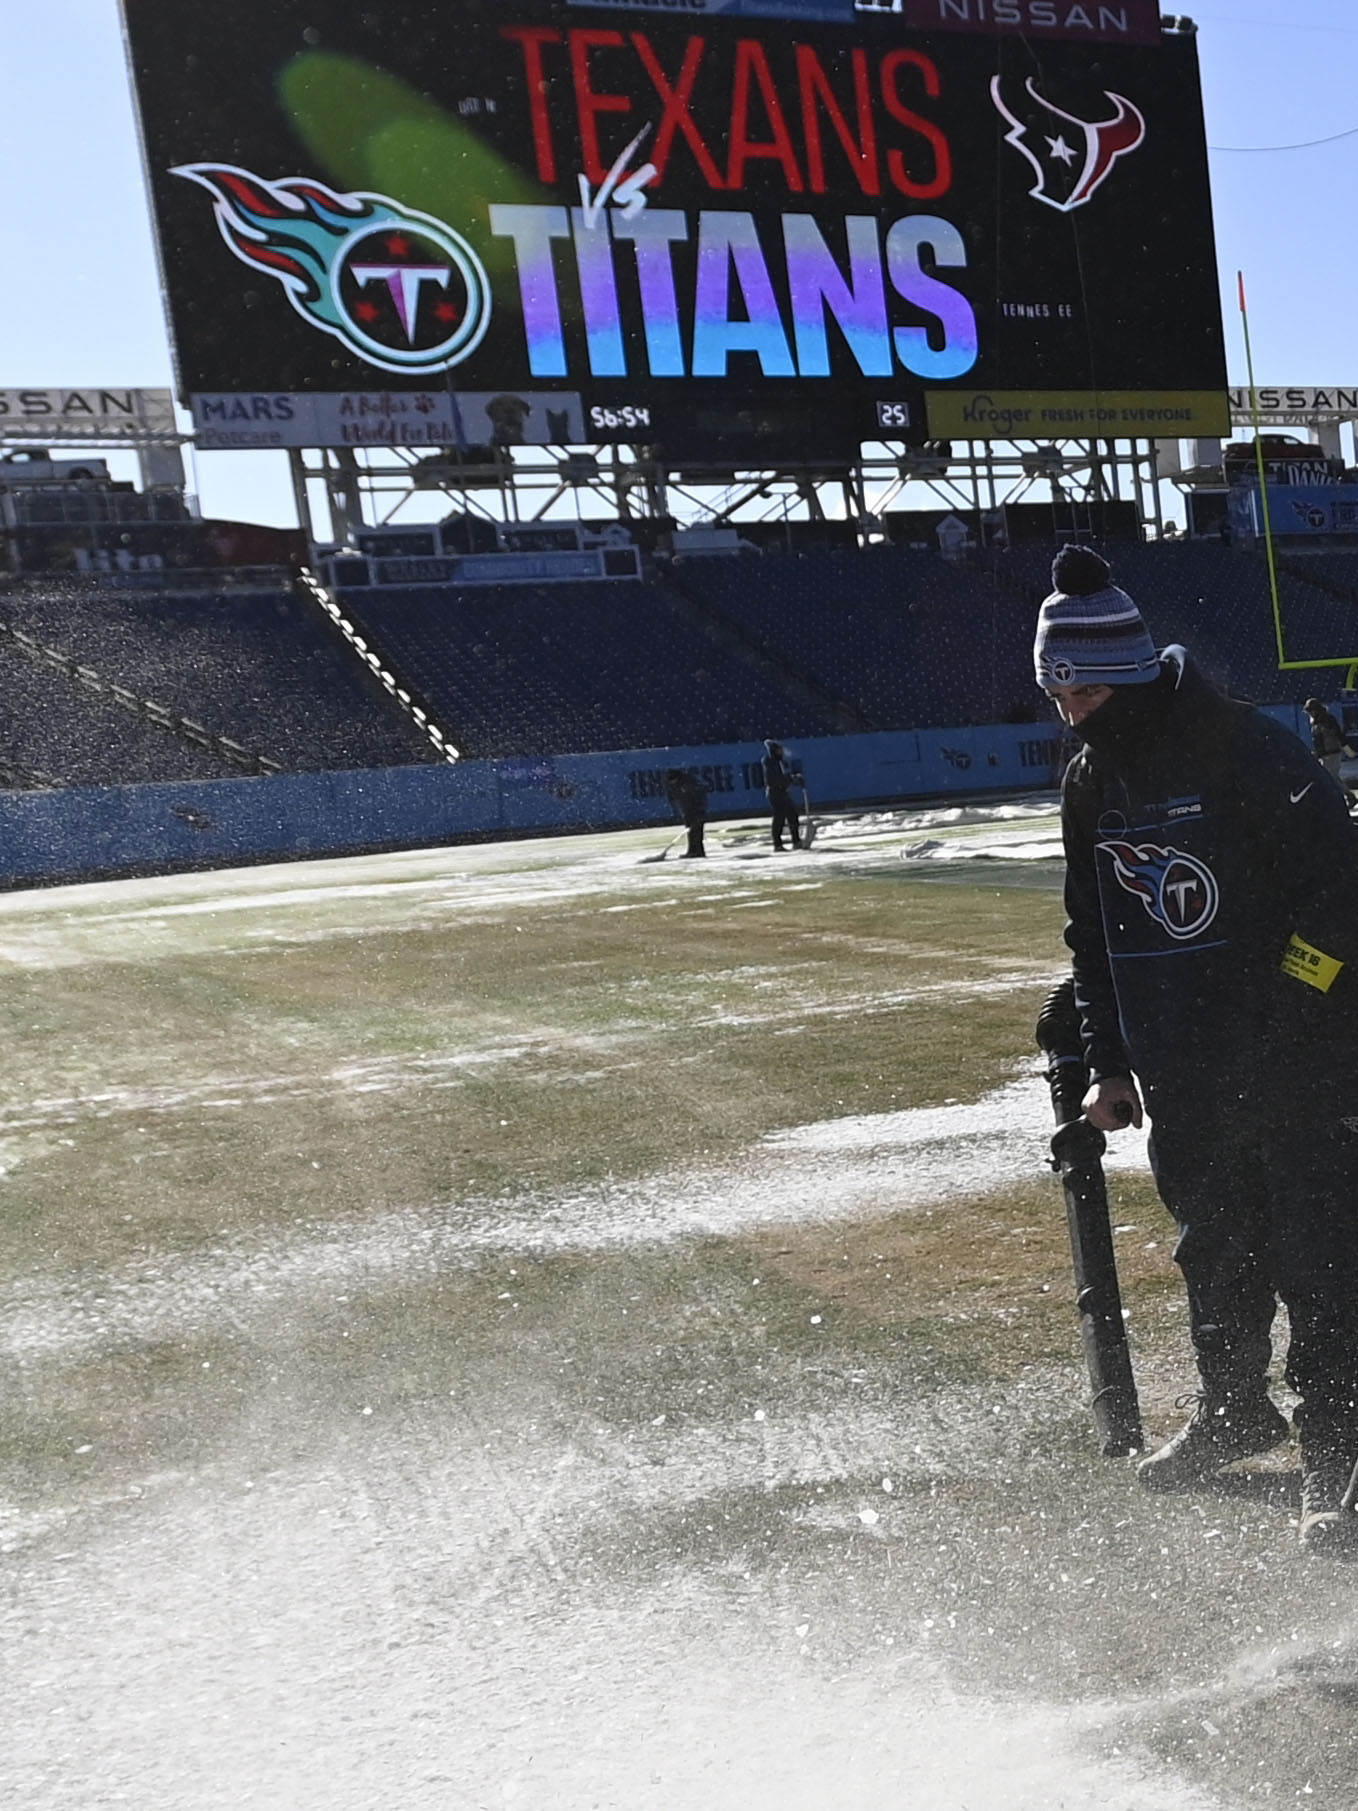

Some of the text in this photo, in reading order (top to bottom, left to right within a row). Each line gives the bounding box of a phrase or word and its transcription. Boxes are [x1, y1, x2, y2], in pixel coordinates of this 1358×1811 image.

[938, 0, 1130, 31] NISSAN
[501, 25, 952, 199] TEXANS
[488, 203, 979, 380] TITANS
[202, 396, 295, 421] MARS
[1228, 390, 1358, 409] NISSAN
[590, 405, 650, 429] 56:54
[881, 404, 906, 424] 25
[963, 395, 1032, 434] Kroger
[1041, 407, 1084, 422] FRESH
[1089, 406, 1117, 421] FOR
[204, 427, 282, 444] Petcare
[628, 764, 735, 799] TENSEE
[1287, 944, 1310, 962] EEK
[1308, 953, 1322, 967] 16
